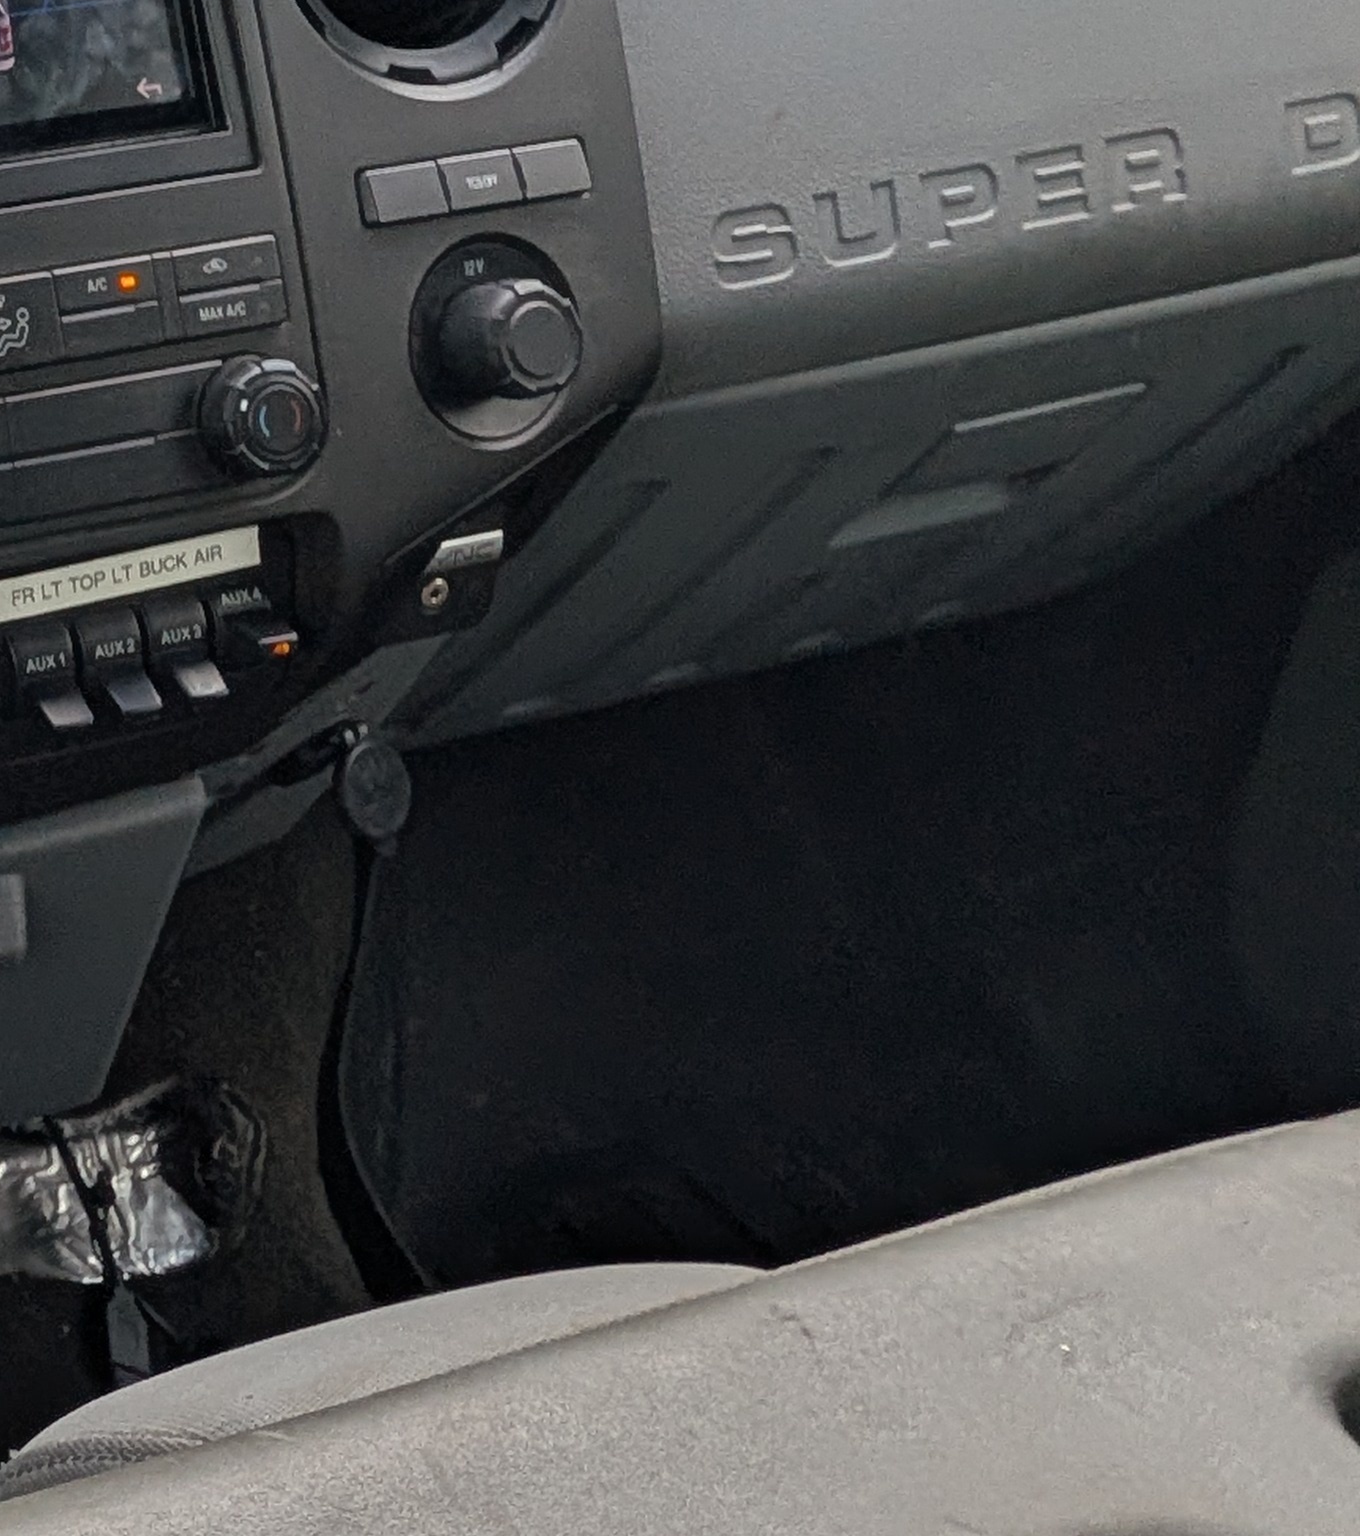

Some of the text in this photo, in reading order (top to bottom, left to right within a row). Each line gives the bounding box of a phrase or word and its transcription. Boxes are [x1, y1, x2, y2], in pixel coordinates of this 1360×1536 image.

[712, 127, 1188, 291] SUPER
[87, 276, 108, 293] A/C
[199, 301, 247, 321] MAX A/C
[11, 544, 223, 607] FR LT TOP LT BUCK AIR
[221, 588, 250, 608] AUX
[161, 623, 202, 646] AUX 3
[94, 637, 135, 660] AUX 2
[26, 652, 66, 674] AUX 1
